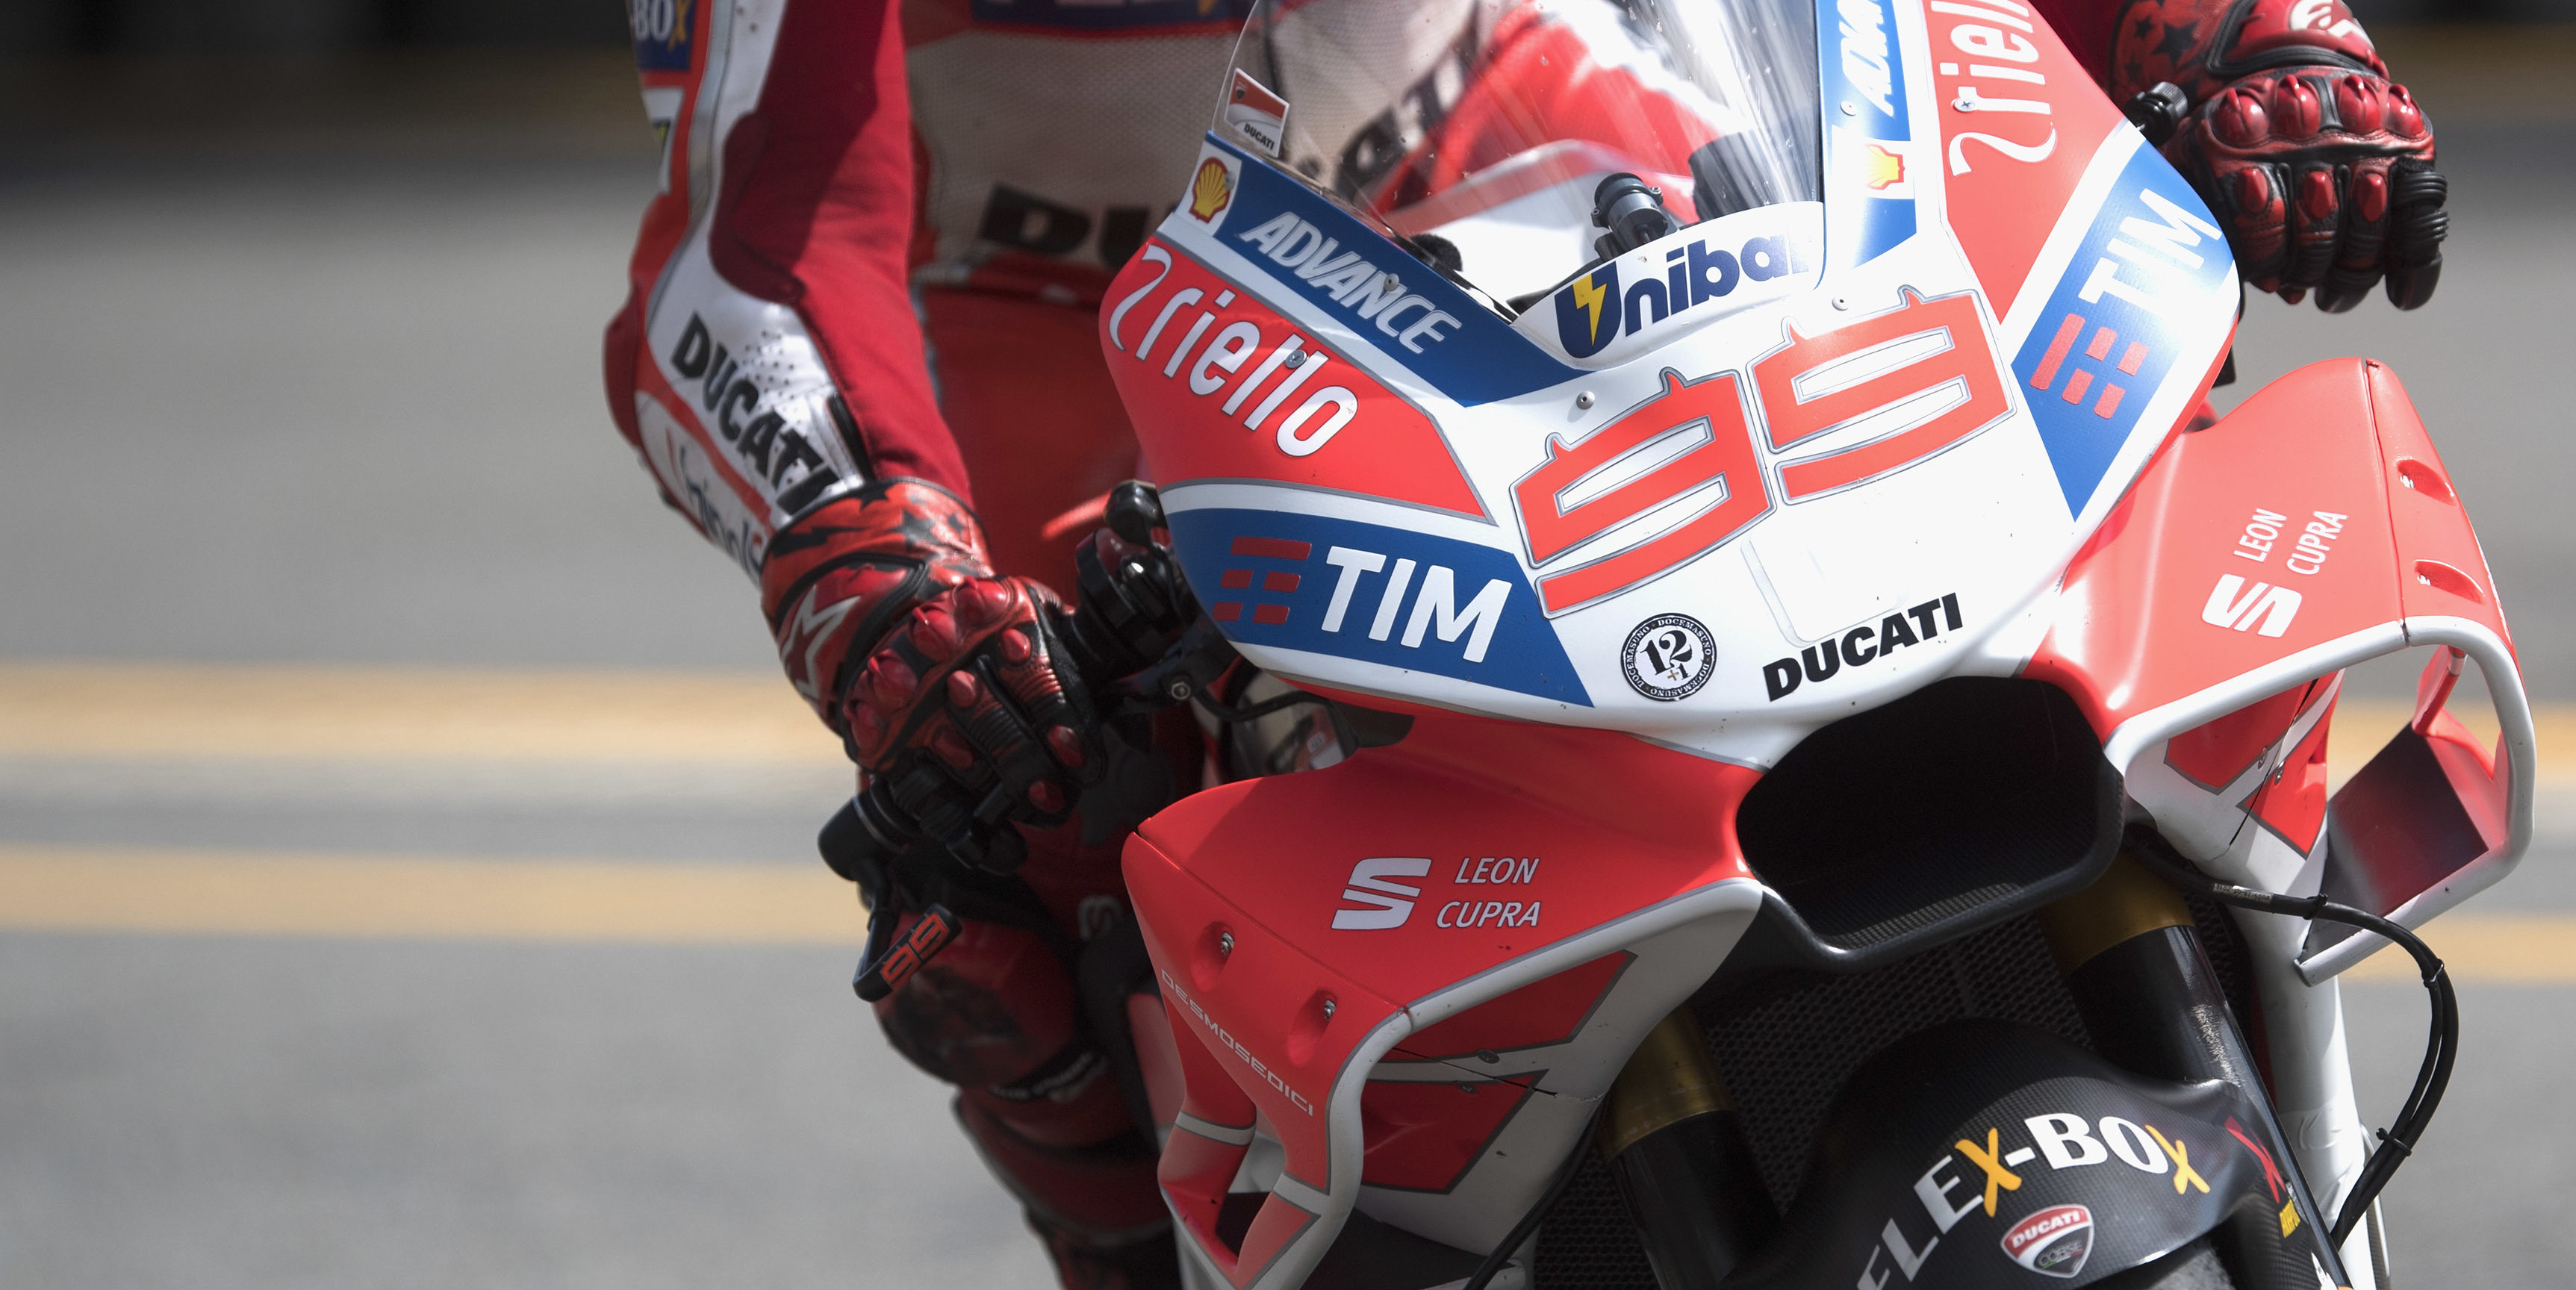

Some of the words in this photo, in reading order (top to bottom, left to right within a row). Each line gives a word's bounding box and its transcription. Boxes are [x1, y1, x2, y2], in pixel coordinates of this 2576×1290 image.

[1243, 122, 1275, 150] DUCATI
[1238, 211, 1463, 355] ADVANCE
[2078, 187, 2223, 305] TIM
[670, 311, 842, 515] DUCATI
[1508, 284, 2017, 621] 99
[2233, 508, 2287, 563] LEON
[2286, 511, 2348, 576] CUPRA
[1321, 546, 1513, 663] TIM
[1762, 592, 1964, 702] DUCATI
[1639, 629, 1693, 676] 12
[1436, 901, 1542, 929] CUPRA
[1455, 858, 1541, 885] LEON
[1160, 968, 1314, 1117] DESMOSEDICI
[2012, 1210, 2081, 1249] DUCATI
